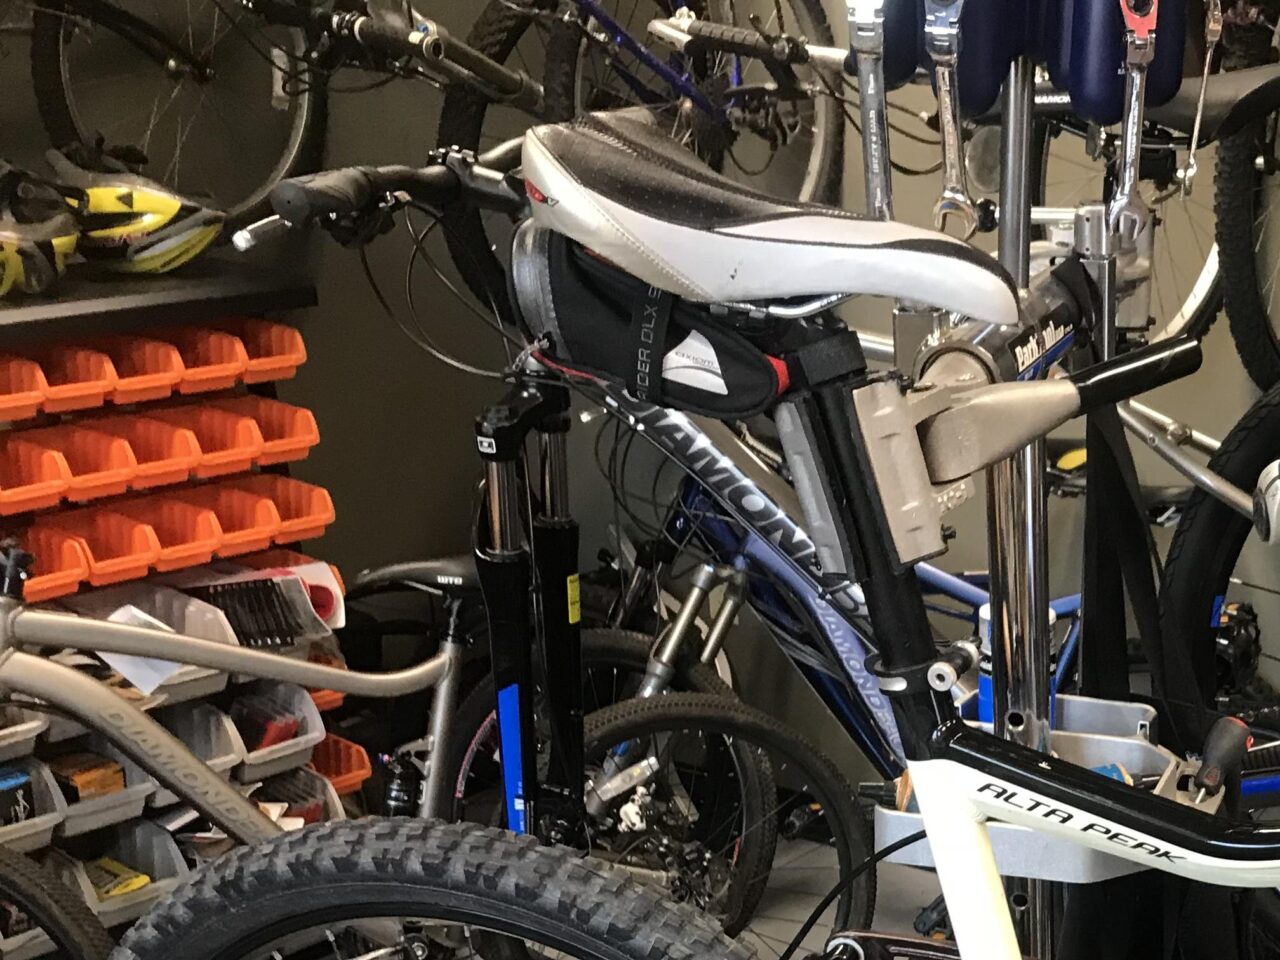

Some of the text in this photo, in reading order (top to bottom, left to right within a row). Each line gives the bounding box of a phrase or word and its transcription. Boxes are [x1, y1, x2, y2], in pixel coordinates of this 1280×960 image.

[640, 304, 659, 344] DLX
[674, 350, 715, 368] axiom
[977, 780, 1192, 866] ALTA PEAK
